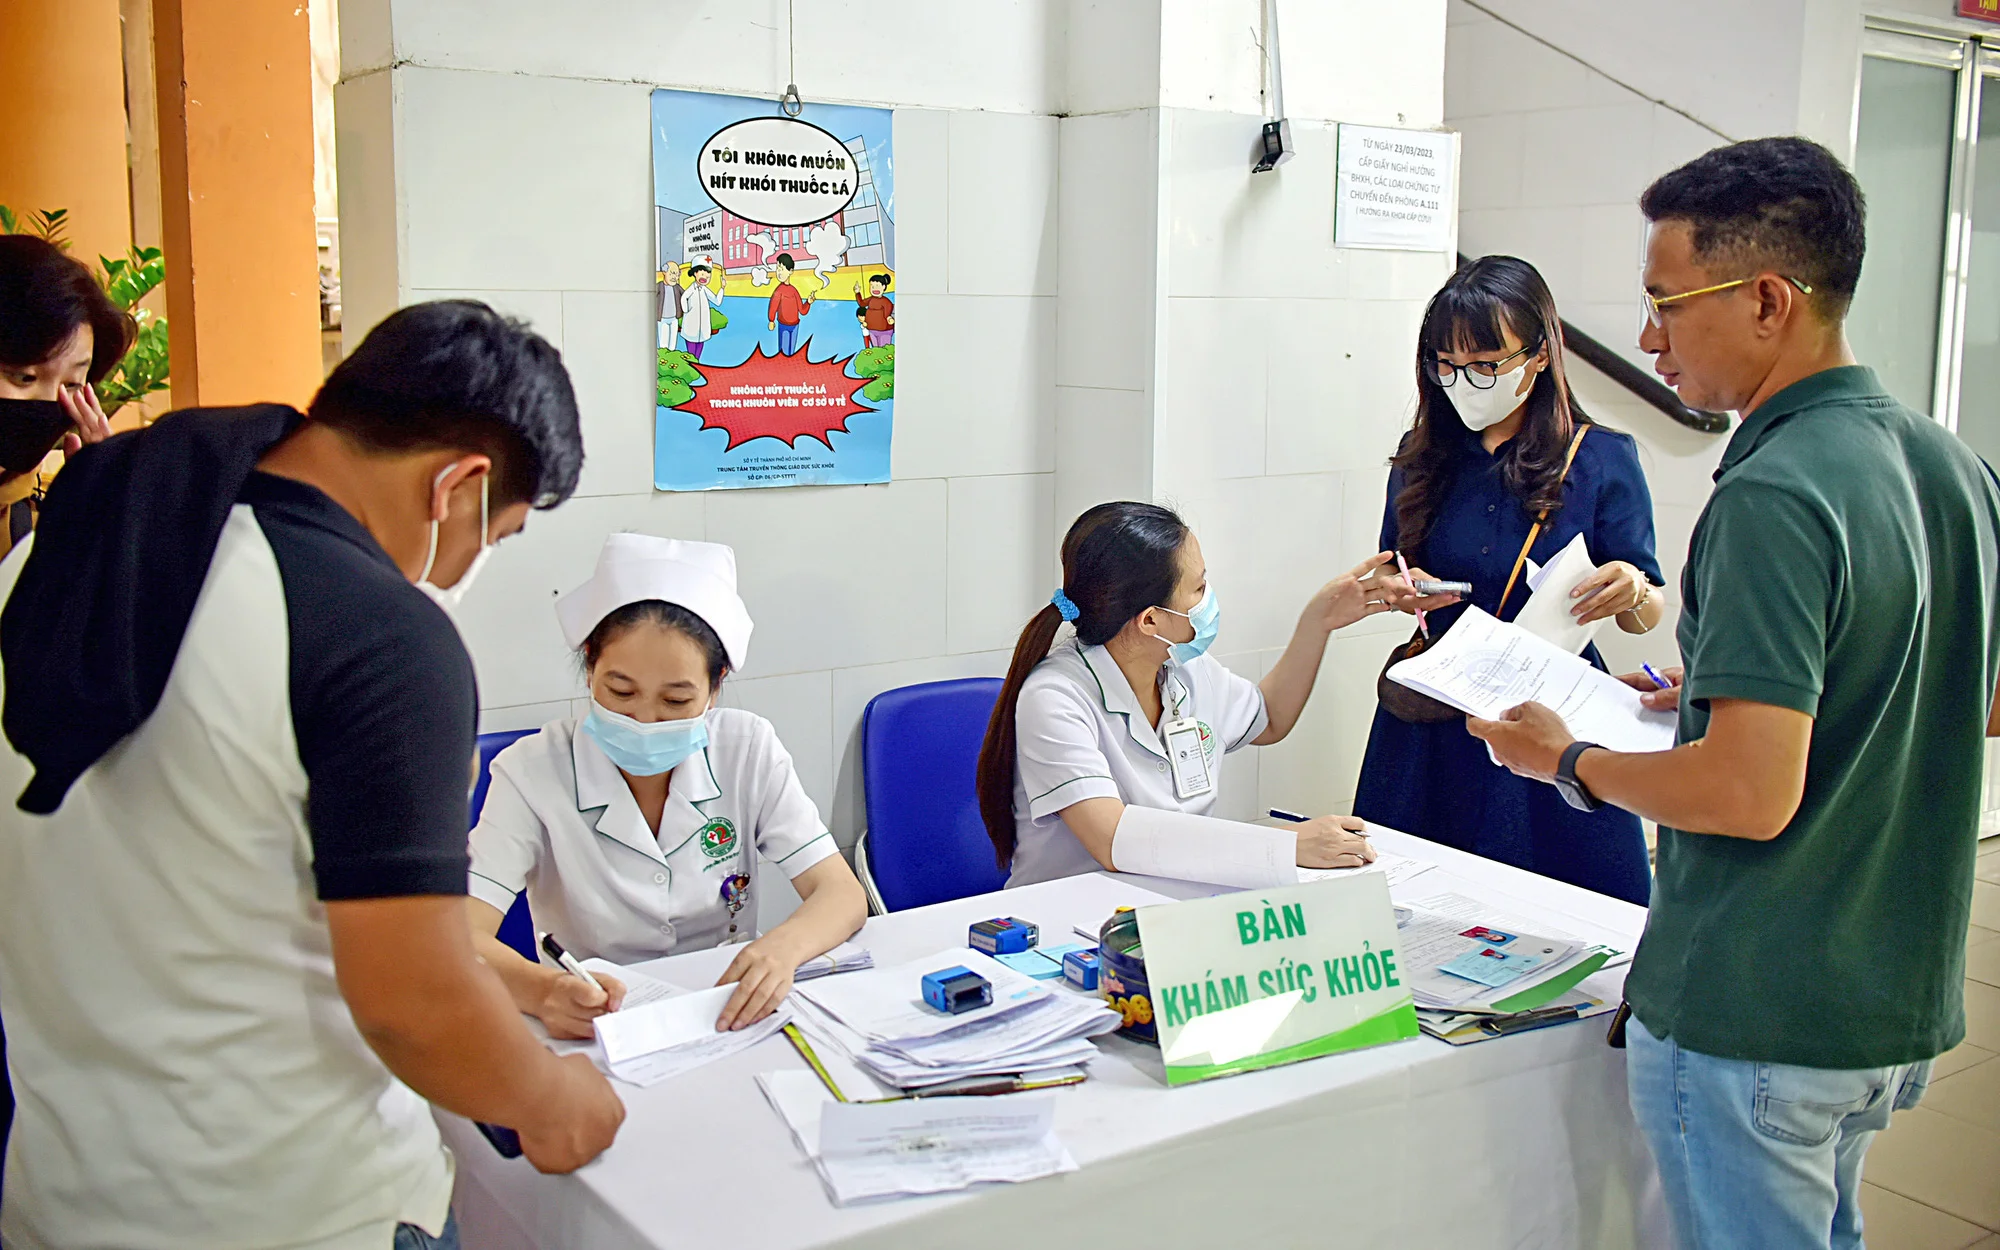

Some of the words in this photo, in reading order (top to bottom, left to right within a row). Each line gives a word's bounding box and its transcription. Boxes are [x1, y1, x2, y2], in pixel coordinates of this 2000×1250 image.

[1374, 140, 1393, 151] NGÀY
[712, 147, 738, 163] TÔI
[745, 150, 797, 168] KHÔNG
[800, 150, 845, 170] MUỐN
[1359, 156, 1372, 168] CẤP
[1374, 158, 1390, 170] GIẤY
[710, 172, 736, 189] HÍT
[739, 174, 776, 192] KHÓI
[779, 174, 829, 194] THUỐC
[832, 179, 850, 195] LÁ
[1351, 173, 1372, 186] BHXH,
[1374, 175, 1388, 187] CÁC
[1405, 180, 1429, 193] CHỨNG
[1379, 192, 1393, 204] ĐẾN
[1395, 196, 1419, 207] PHÒNG
[1420, 200, 1439, 210] A.111
[1391, 211, 1406, 220] KHOA
[730, 384, 764, 395] KHÔNG
[765, 384, 784, 395] HÚT
[784, 382, 814, 395] THUỐC
[815, 383, 827, 395] LÁ
[709, 399, 742, 408] TRONG
[743, 397, 775, 408] KHUÔN
[777, 397, 799, 407] VIÊN
[802, 398, 814, 407] CƠ
[815, 395, 826, 407] SỞ
[828, 398, 834, 407] Y
[835, 394, 847, 407] TẾ
[1236, 899, 1307, 945] BÀN
[1161, 969, 1249, 1028] KHÁM
[1258, 957, 1317, 1004] SỨC
[1324, 940, 1400, 998] KHỎE
